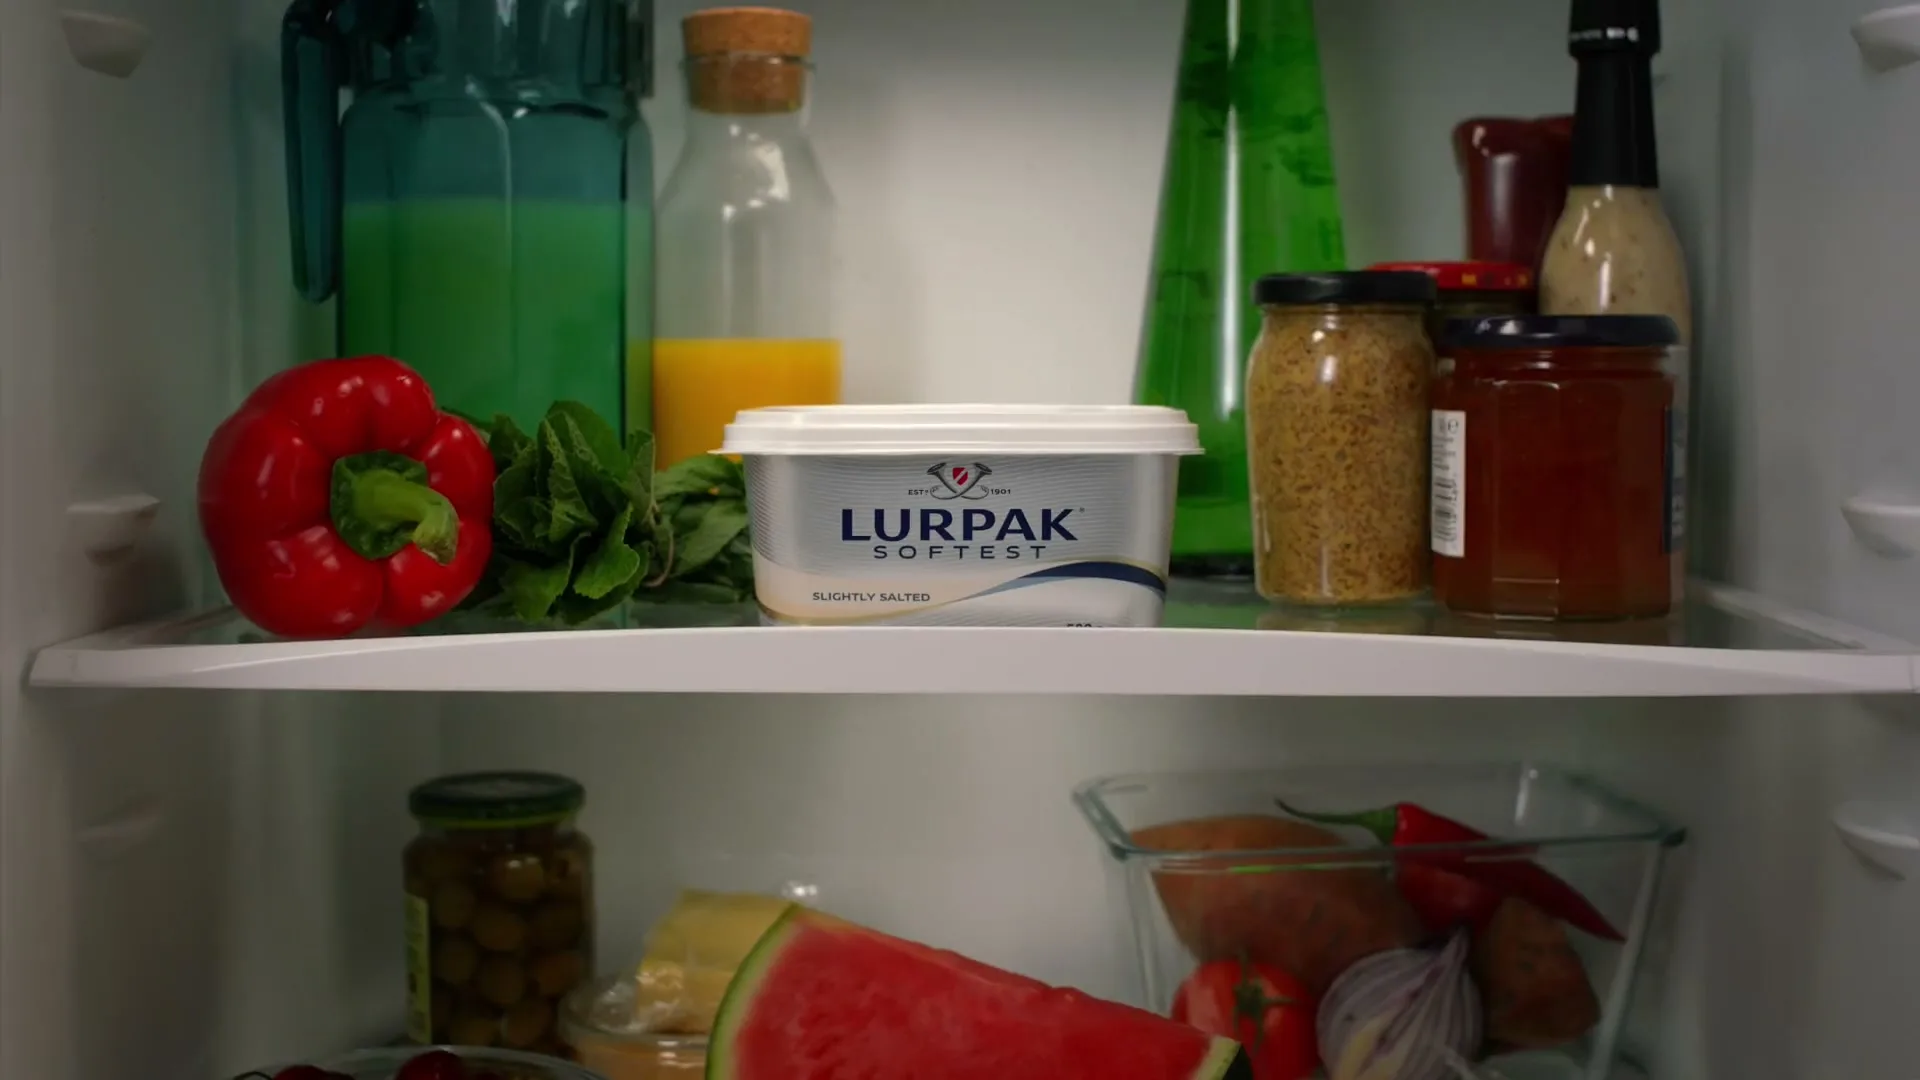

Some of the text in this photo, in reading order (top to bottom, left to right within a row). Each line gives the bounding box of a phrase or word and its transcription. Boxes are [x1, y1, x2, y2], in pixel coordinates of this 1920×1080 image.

[990, 488, 1011, 496] 1901
[841, 508, 1078, 541] LURPAK
[873, 545, 1046, 560] SOFTEST
[812, 592, 931, 602] SLIGHTLY SALTED
